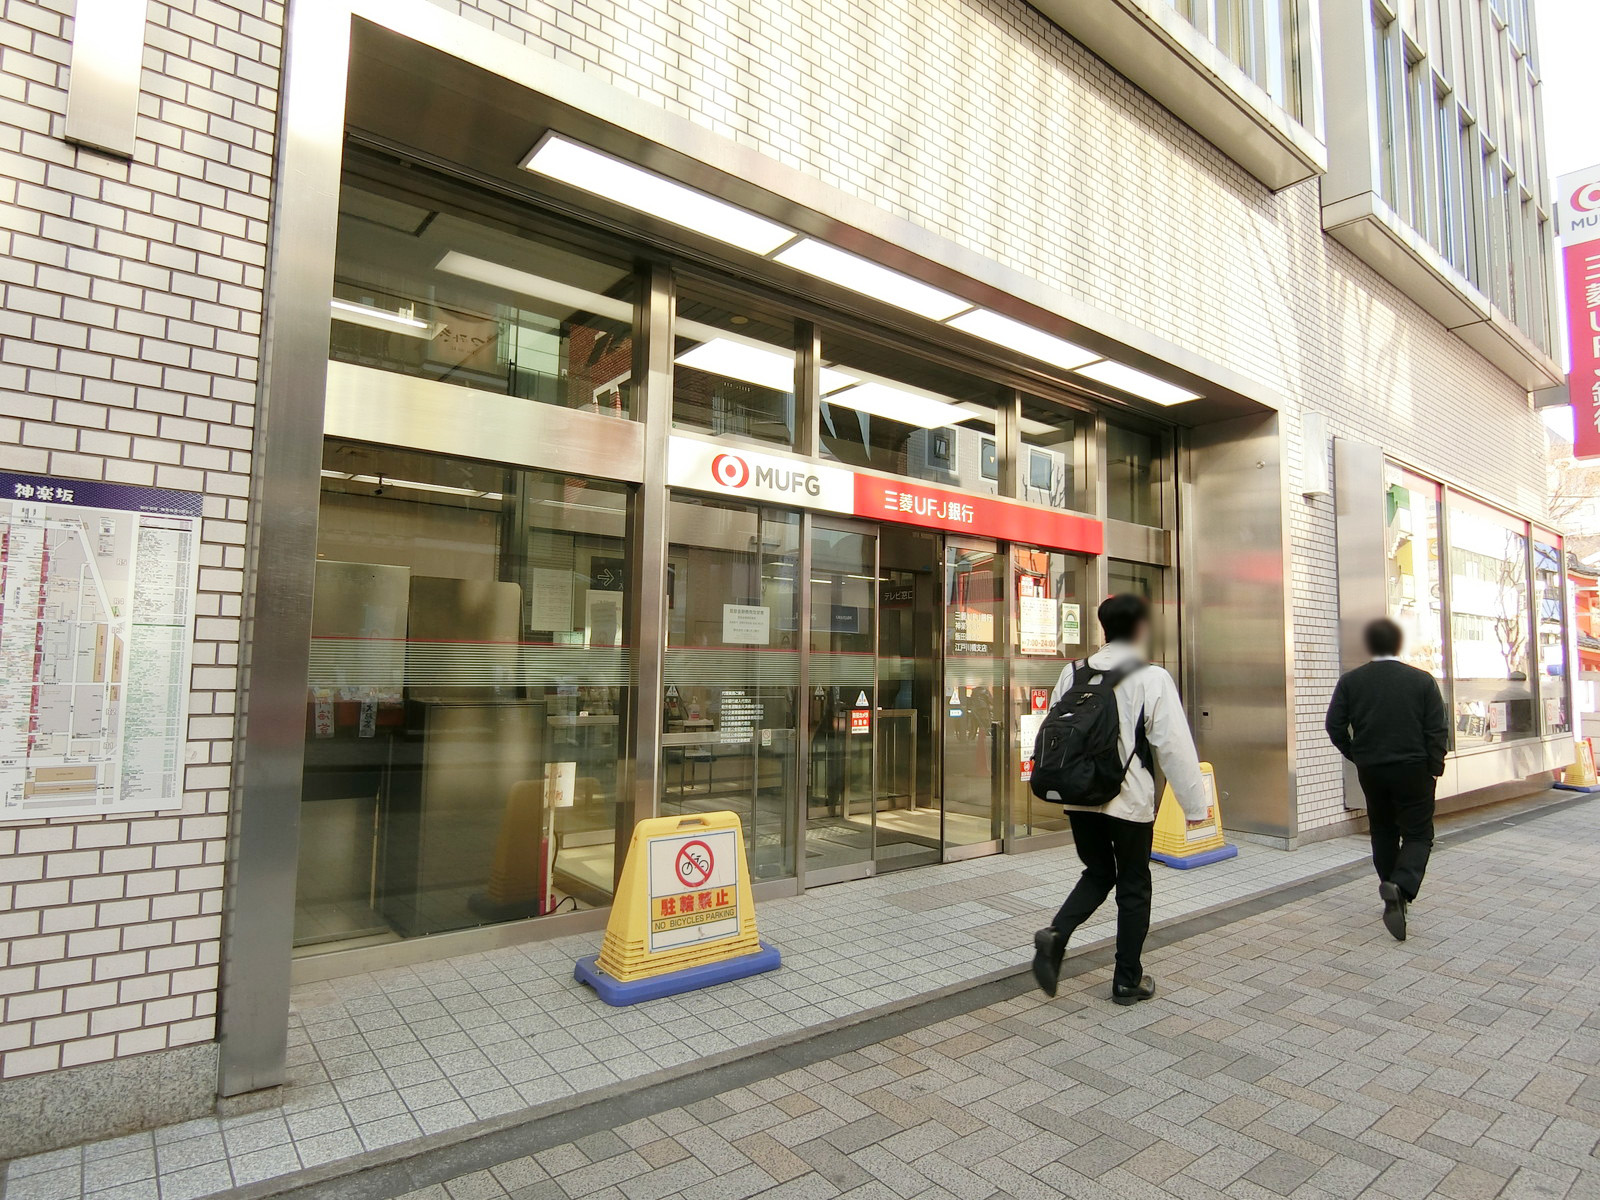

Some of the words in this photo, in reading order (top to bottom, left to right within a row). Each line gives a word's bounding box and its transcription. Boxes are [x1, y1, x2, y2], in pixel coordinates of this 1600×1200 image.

[1571, 213, 1600, 232] MU
[14, 482, 75, 503] 神楽坂
[755, 465, 821, 497] MUFG
[883, 488, 974, 525] 三菱UFJ銀行
[660, 888, 729, 917] 駐輪禁止
[654, 921, 666, 931] NO
[669, 914, 704, 928] BICYCLES
[705, 908, 735, 921] PARKING
